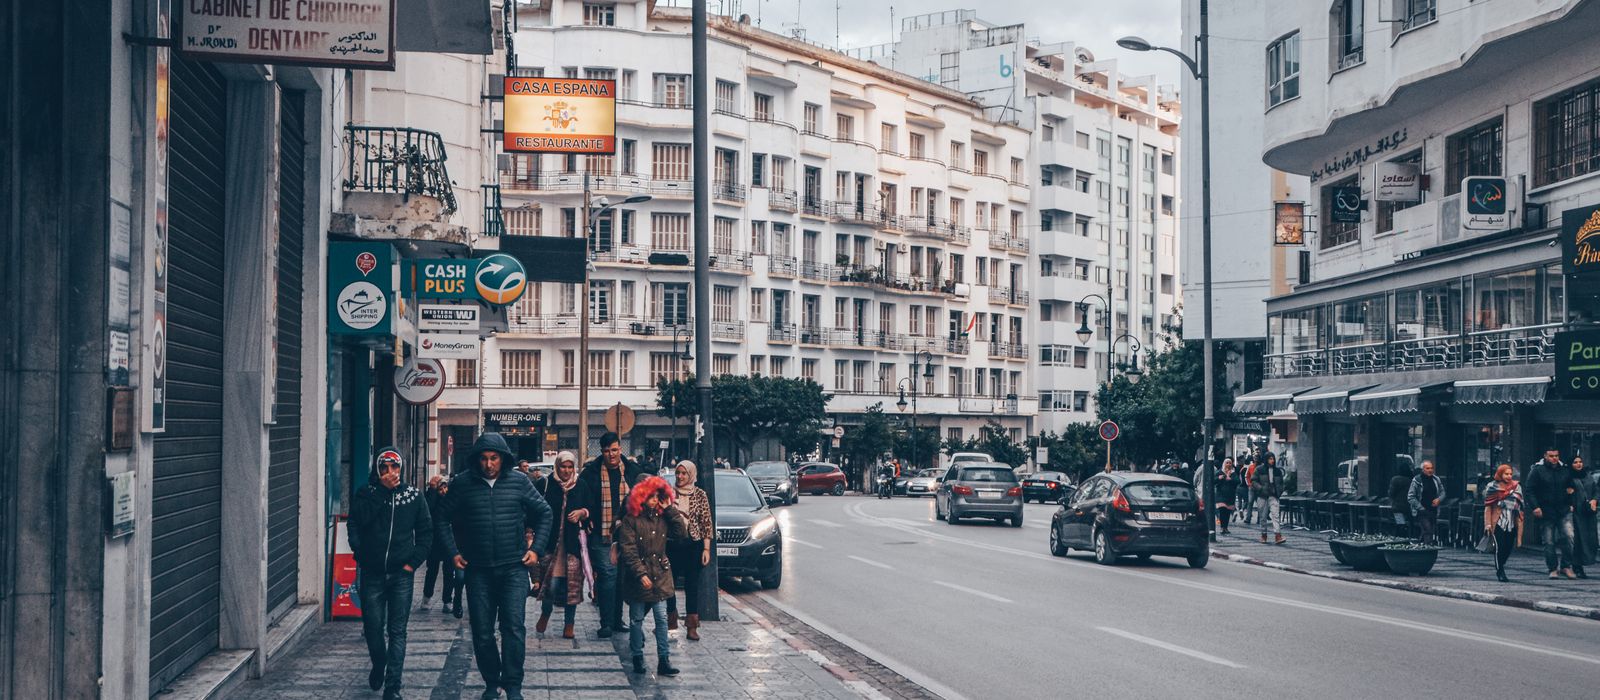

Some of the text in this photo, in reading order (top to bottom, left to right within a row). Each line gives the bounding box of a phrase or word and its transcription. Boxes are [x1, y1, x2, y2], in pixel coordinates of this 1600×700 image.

[190, 0, 383, 25] CABINET DE CHIRURGI
[338, 31, 377, 43] الدكتور
[512, 81, 609, 96] CASA ESPAÑA
[516, 137, 604, 150] RESTAURANTE
[424, 264, 467, 278] CASH
[424, 279, 465, 293] PLUS
[455, 310, 473, 319] WU
[433, 342, 475, 350] MoneyGram
